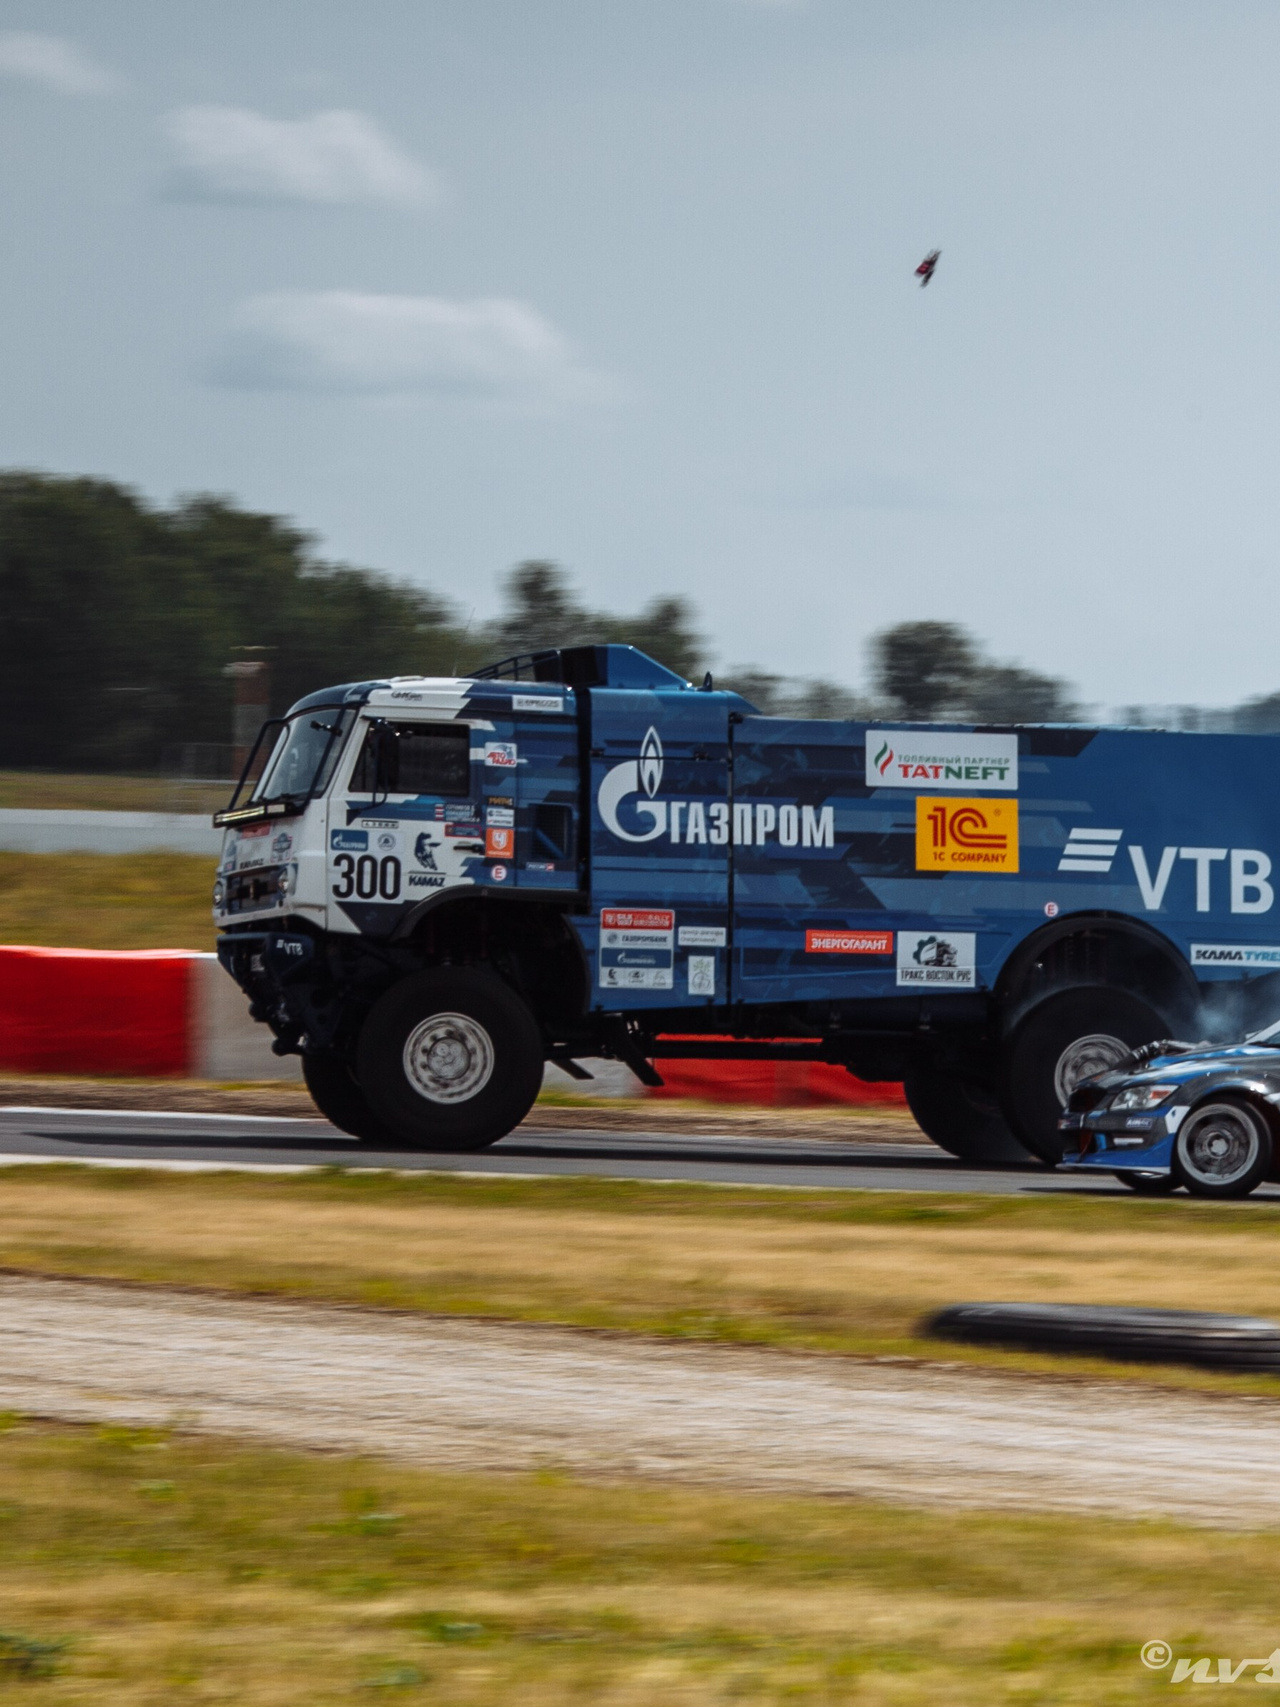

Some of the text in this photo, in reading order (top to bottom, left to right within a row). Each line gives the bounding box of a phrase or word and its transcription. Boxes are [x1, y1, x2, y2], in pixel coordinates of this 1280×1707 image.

[964, 757, 1010, 765] ПАРТНЕР
[898, 764, 1010, 780] TATNEFT
[670, 801, 835, 848] ГАЗПРОМ
[951, 852, 1007, 863] COMPANY
[332, 853, 402, 900] 300
[408, 875, 445, 887] KAMAZ
[1128, 845, 1274, 914] VTB
[284, 942, 303, 955] VTB
[811, 938, 887, 950] ЭНЕРГОГАРАНТ
[1195, 950, 1243, 961] KAMA
[901, 970, 971, 981] ТРАКС ВОСТОК РУС
